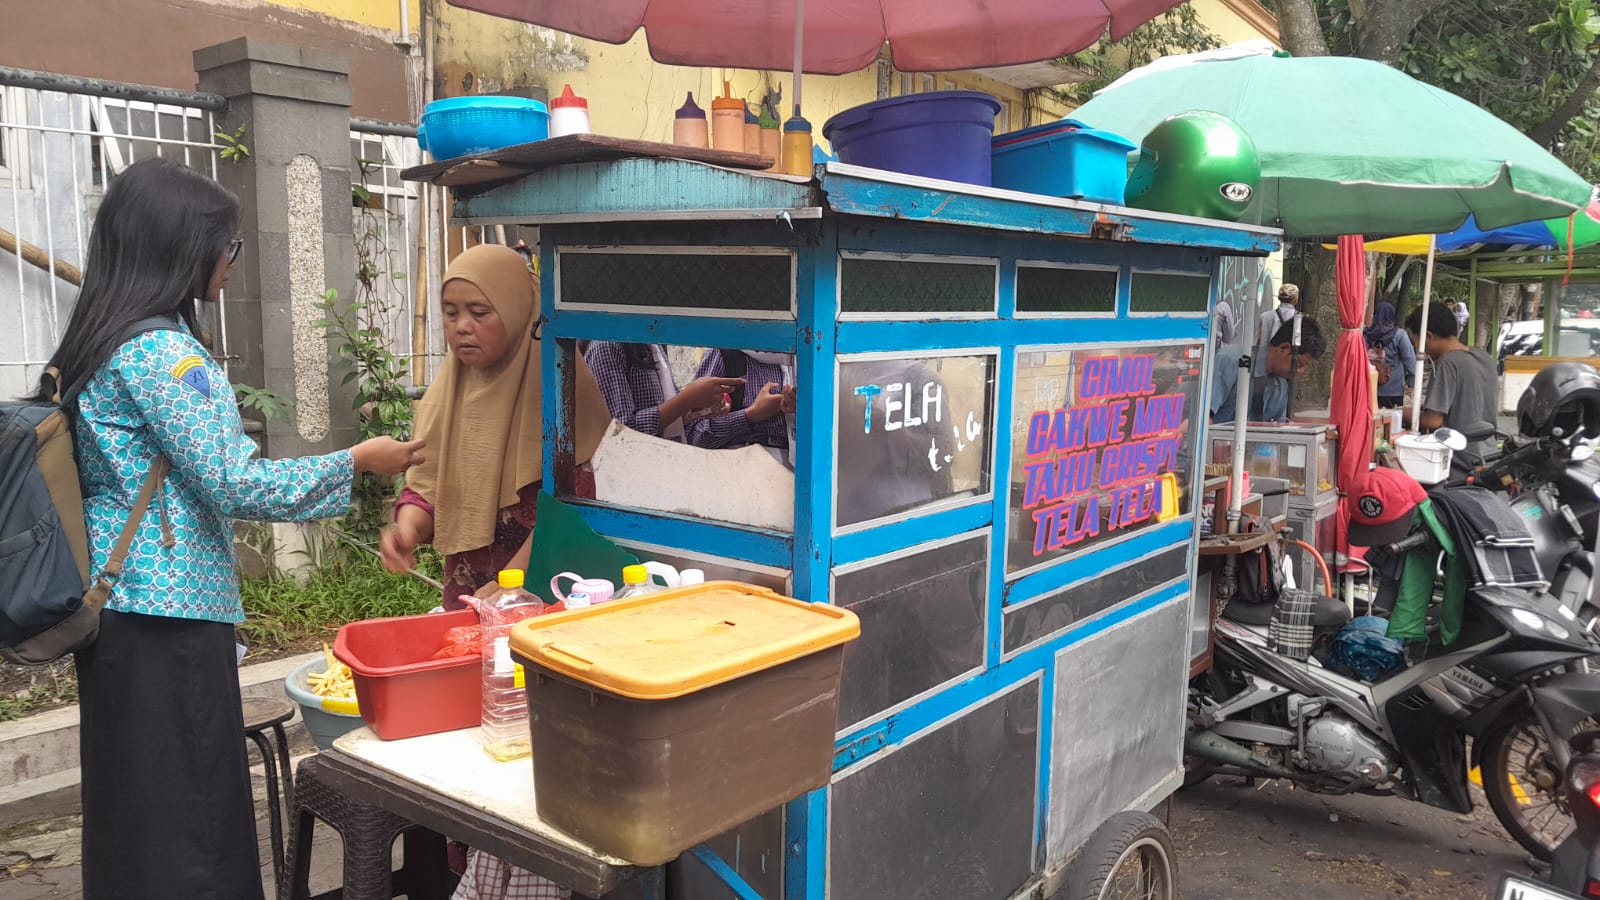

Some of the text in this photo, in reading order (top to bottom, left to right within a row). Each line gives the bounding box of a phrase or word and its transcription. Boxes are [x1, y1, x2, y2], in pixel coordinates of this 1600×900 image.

[1079, 353, 1157, 401] CIMOL
[853, 382, 942, 434] TELA
[1026, 393, 1186, 459] CAKWE MINI
[1023, 433, 1184, 510] TAHU CRISPY
[1032, 477, 1163, 556] TELA TELA
[1452, 668, 1484, 689] YAMAHA
